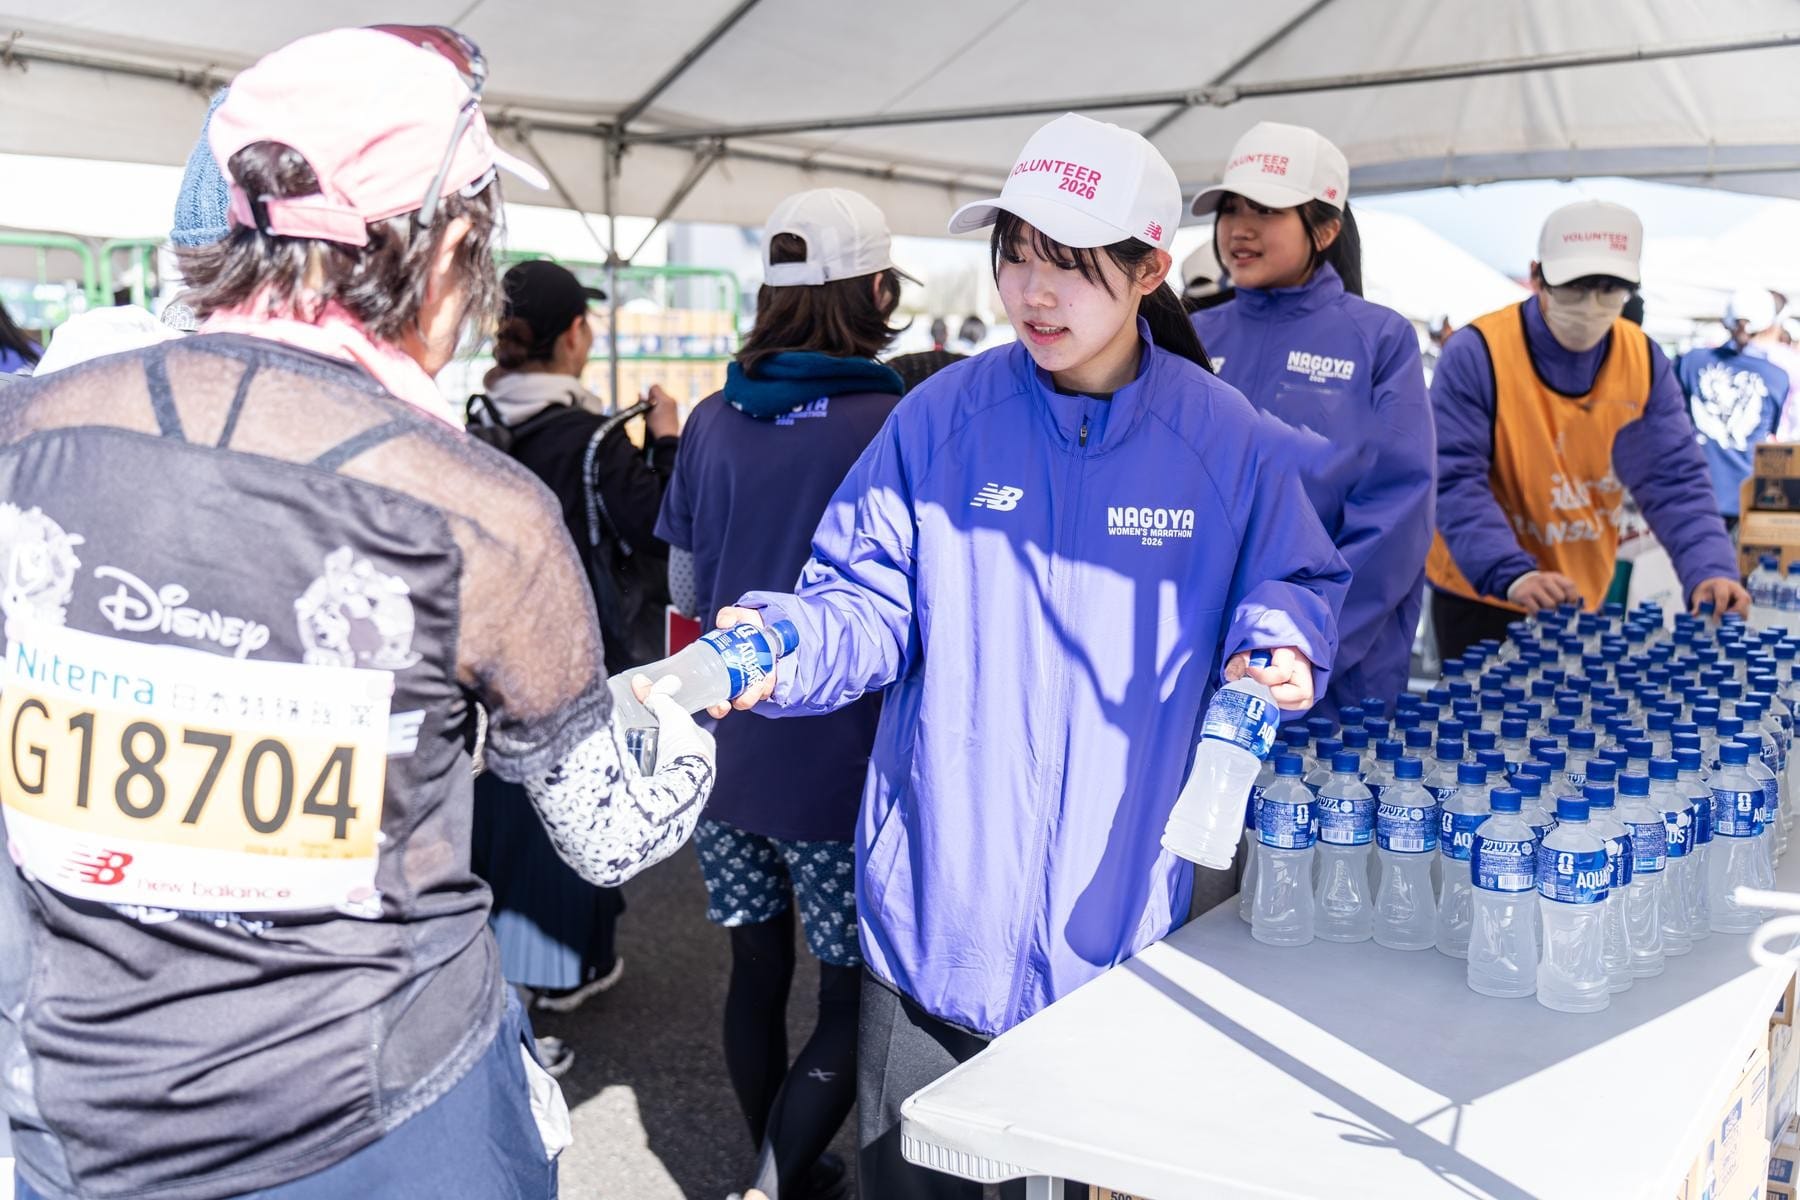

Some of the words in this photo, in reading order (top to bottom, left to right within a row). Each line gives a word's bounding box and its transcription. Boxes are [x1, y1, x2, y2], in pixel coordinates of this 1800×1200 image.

[1058, 177, 1096, 200] 2026
[1288, 350, 1355, 375] NAGOYA
[1107, 506, 1195, 529] NAGOYA
[1108, 527, 1148, 536] WOMEN'S
[1150, 529, 1193, 538] MARATHON
[1141, 536, 1163, 546] 2026
[15, 642, 156, 706] Niterra
[10, 698, 359, 840] G18704
[1480, 838, 1521, 854] アクエリアス
